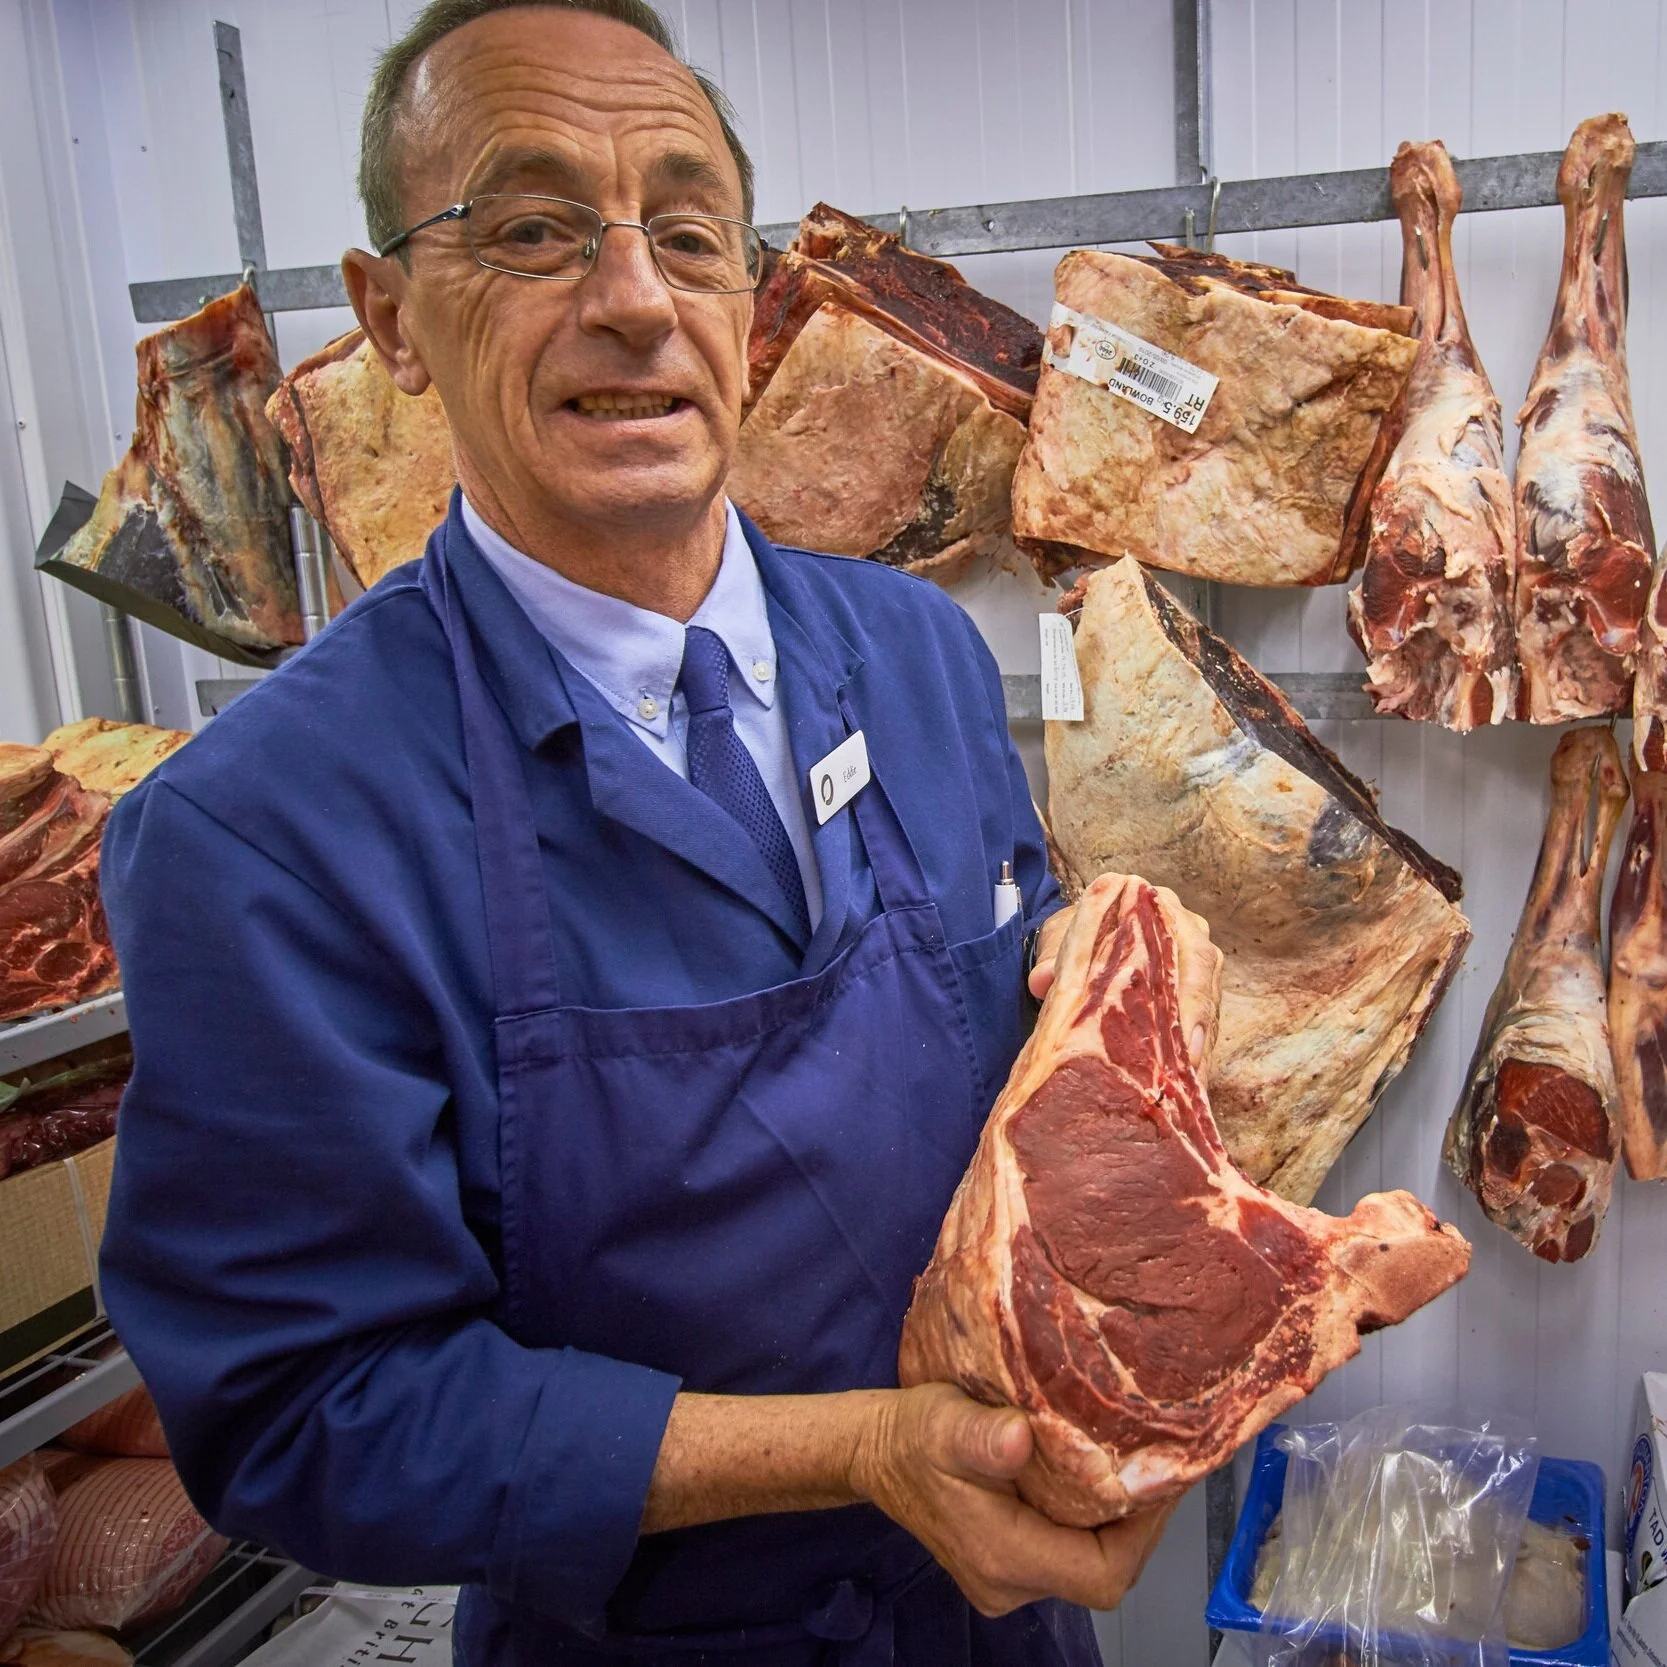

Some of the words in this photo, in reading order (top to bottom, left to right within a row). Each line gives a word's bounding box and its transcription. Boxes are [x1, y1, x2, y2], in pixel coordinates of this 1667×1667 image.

[1108, 377, 1154, 406] BOWLAND
[1184, 393, 1206, 412] RT
[842, 765, 857, 783] Eddie
[1648, 1506, 1664, 1546] TAD
[338, 1618, 399, 1667] Briti
